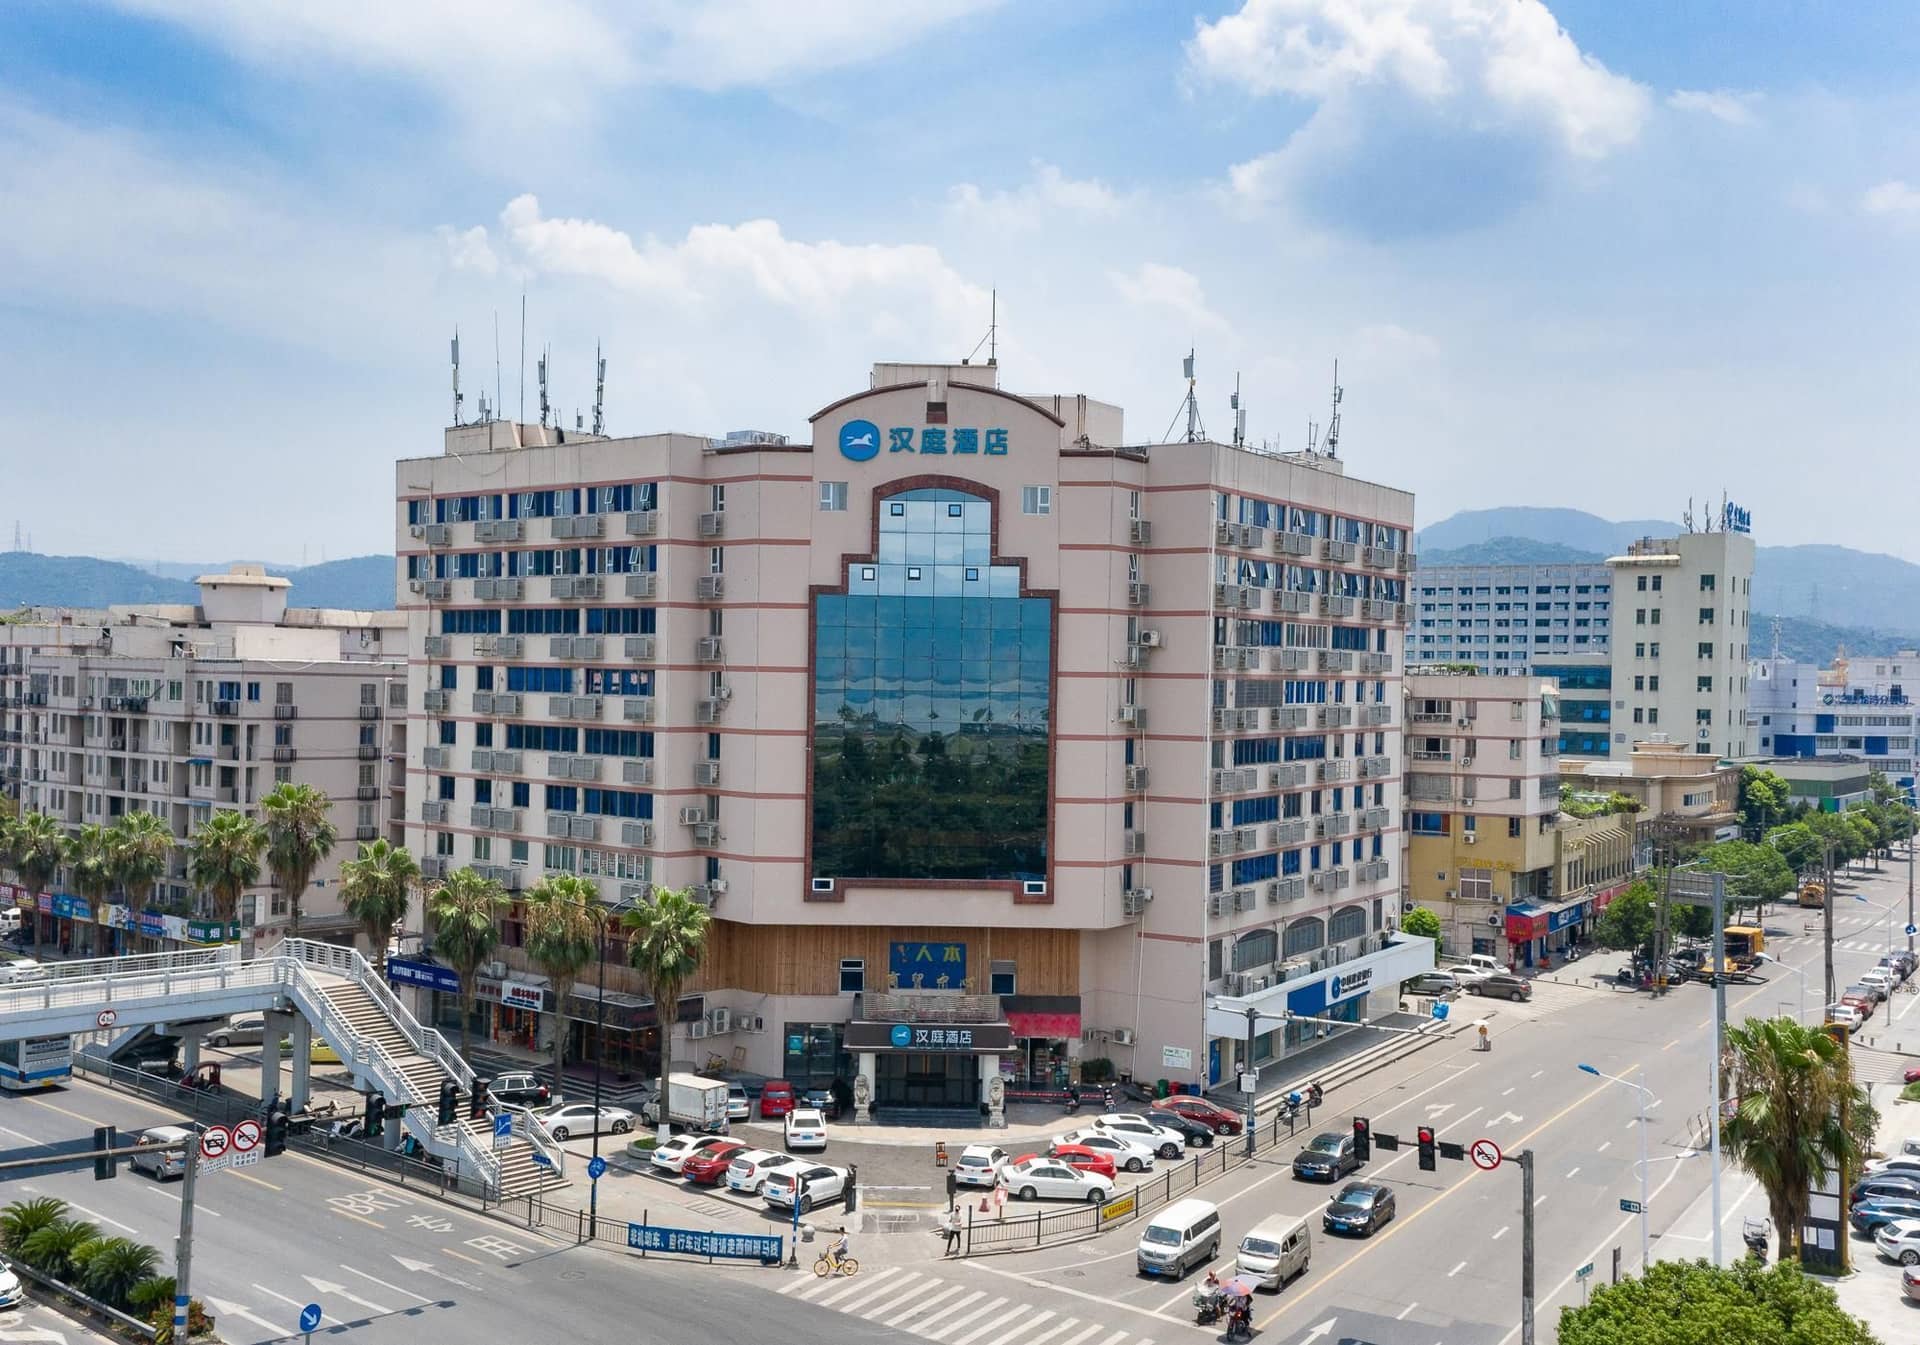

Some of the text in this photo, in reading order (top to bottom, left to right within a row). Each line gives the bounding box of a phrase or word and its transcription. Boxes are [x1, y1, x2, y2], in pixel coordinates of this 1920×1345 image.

[889, 427, 1009, 456] 汉庭酒店
[914, 944, 961, 963] 人本
[915, 1029, 973, 1044] 汉庭酒店
[325, 1188, 414, 1216] BRT
